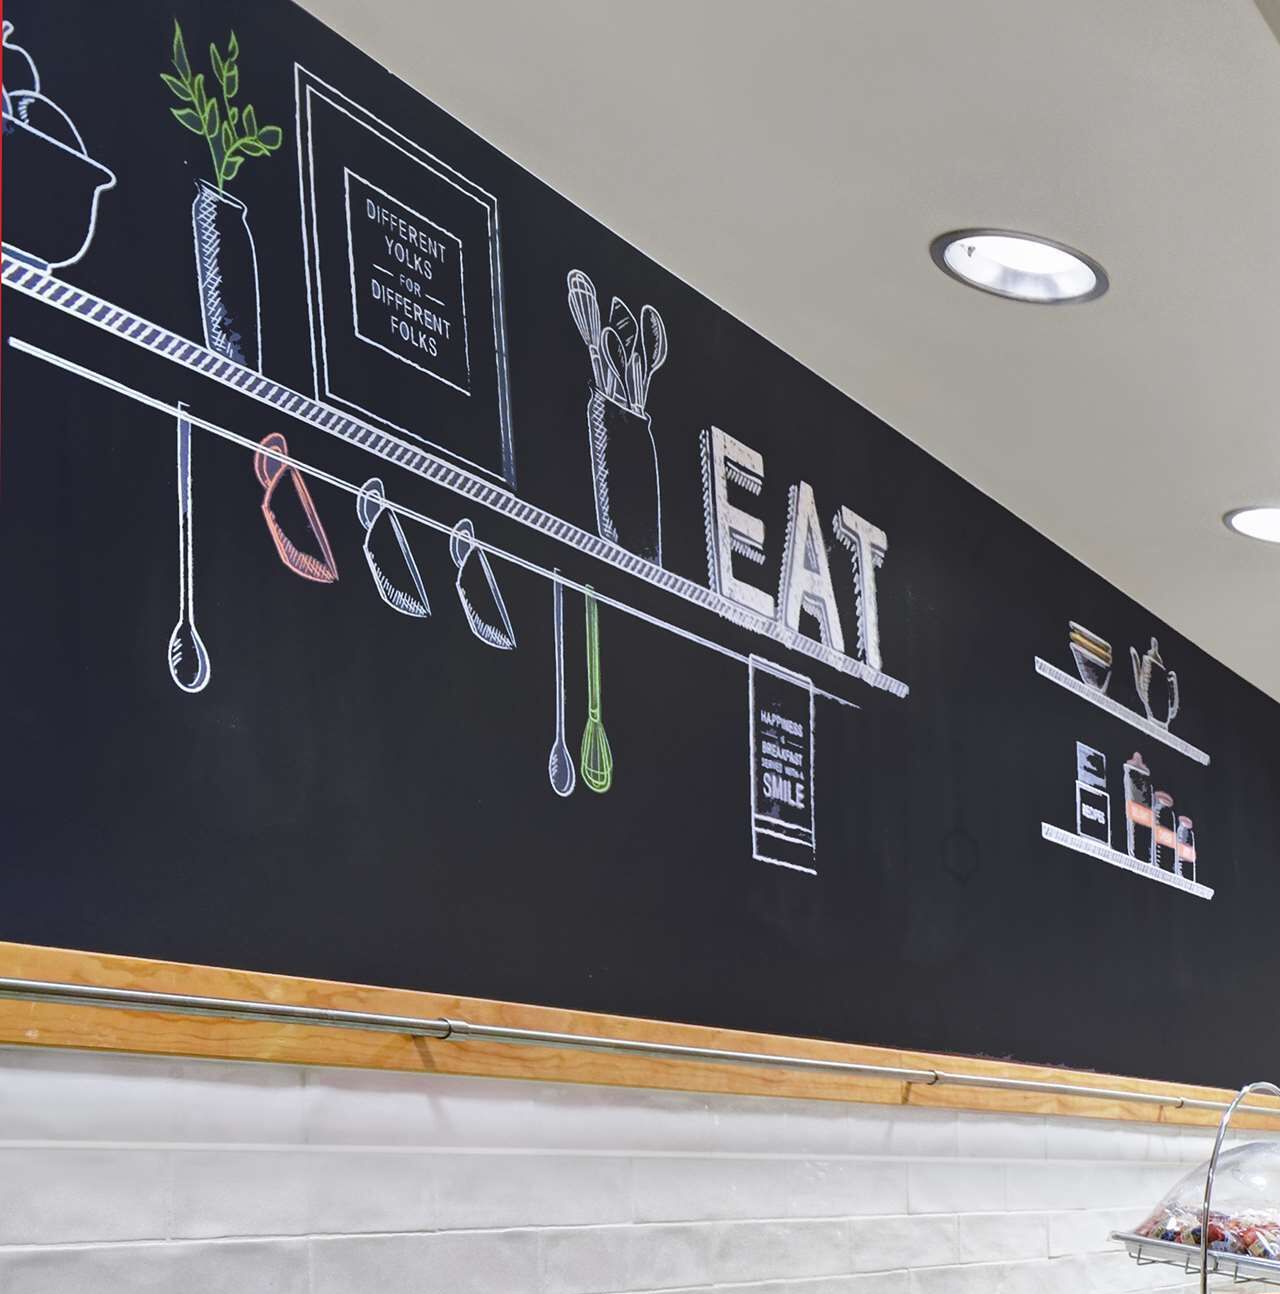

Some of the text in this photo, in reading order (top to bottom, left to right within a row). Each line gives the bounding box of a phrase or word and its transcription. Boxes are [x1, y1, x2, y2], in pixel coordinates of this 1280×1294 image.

[366, 198, 446, 264] DIFFERENT
[385, 235, 432, 280] YOLKS
[371, 278, 450, 339] DIFFERENT
[400, 274, 421, 298] FOR
[390, 315, 438, 357] FOLKS
[700, 425, 888, 671] EAT
[763, 772, 805, 809] SMILE
